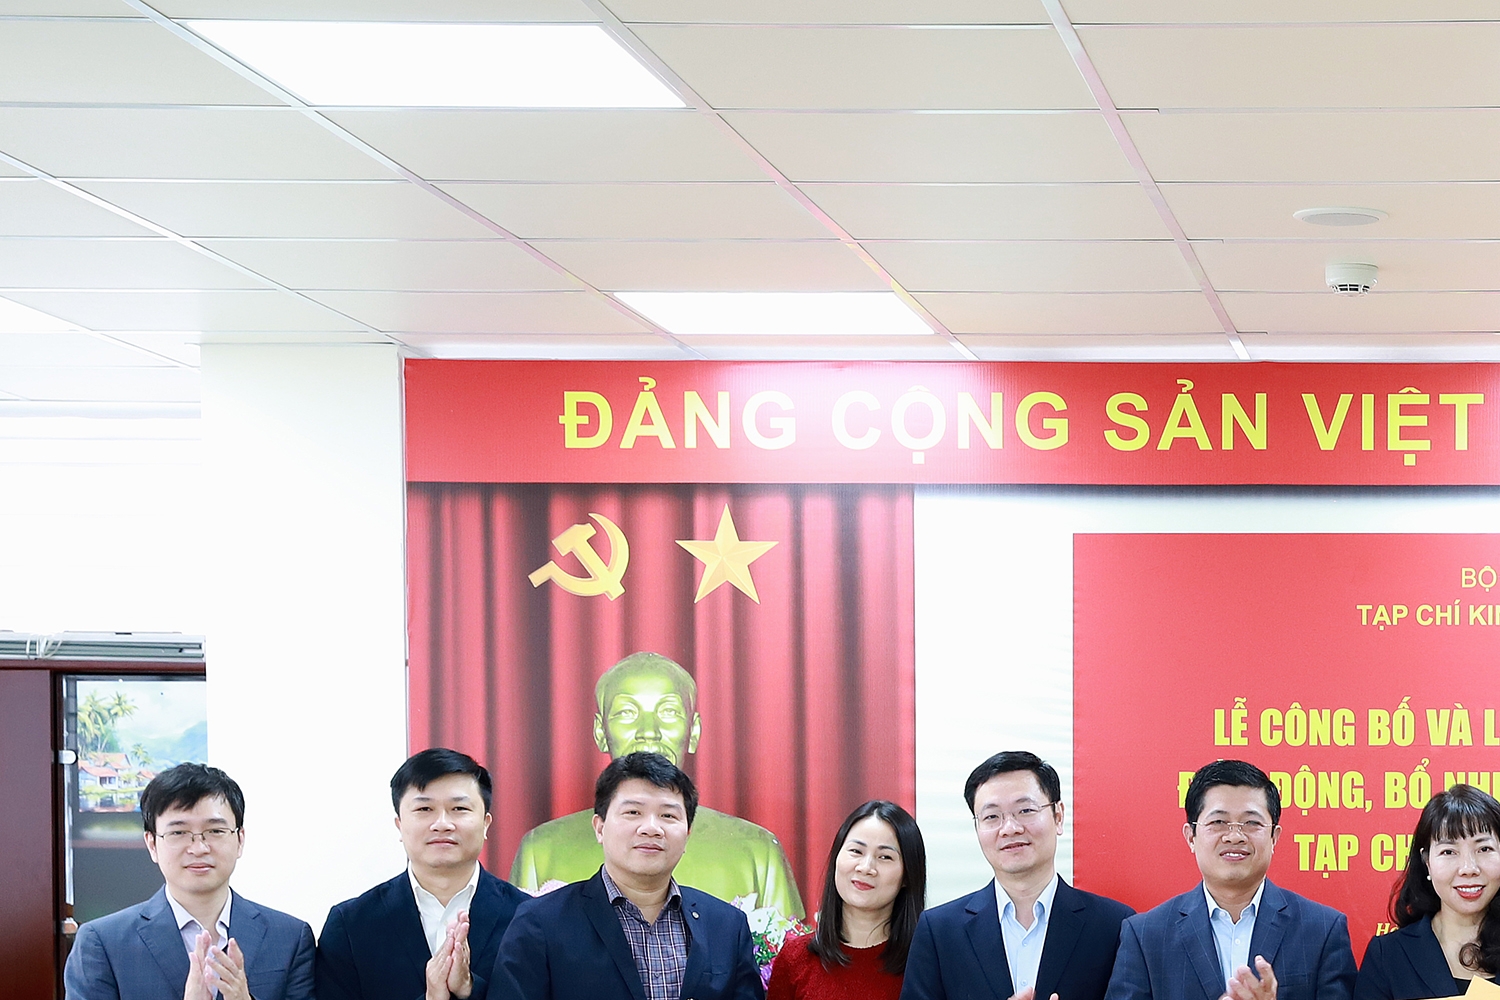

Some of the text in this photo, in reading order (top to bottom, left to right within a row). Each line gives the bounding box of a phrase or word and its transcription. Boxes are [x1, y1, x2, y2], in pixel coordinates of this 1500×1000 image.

[559, 376, 797, 451] ĐẢNG
[831, 385, 1069, 464] CỘNG
[1103, 379, 1267, 451] SẢN
[1301, 386, 1484, 466] VIỆT
[1461, 565, 1498, 592] BỘ
[1356, 604, 1408, 630] TẠP
[1416, 599, 1461, 626] CHÍ
[1213, 697, 1249, 746] LỄ
[1260, 702, 1355, 747] CÔNG
[1368, 696, 1415, 747] BỐ
[1426, 702, 1473, 746] VÀ
[1384, 758, 1432, 809] BỔ
[1294, 833, 1359, 878] TẠP
[1371, 833, 1416, 872] CH
